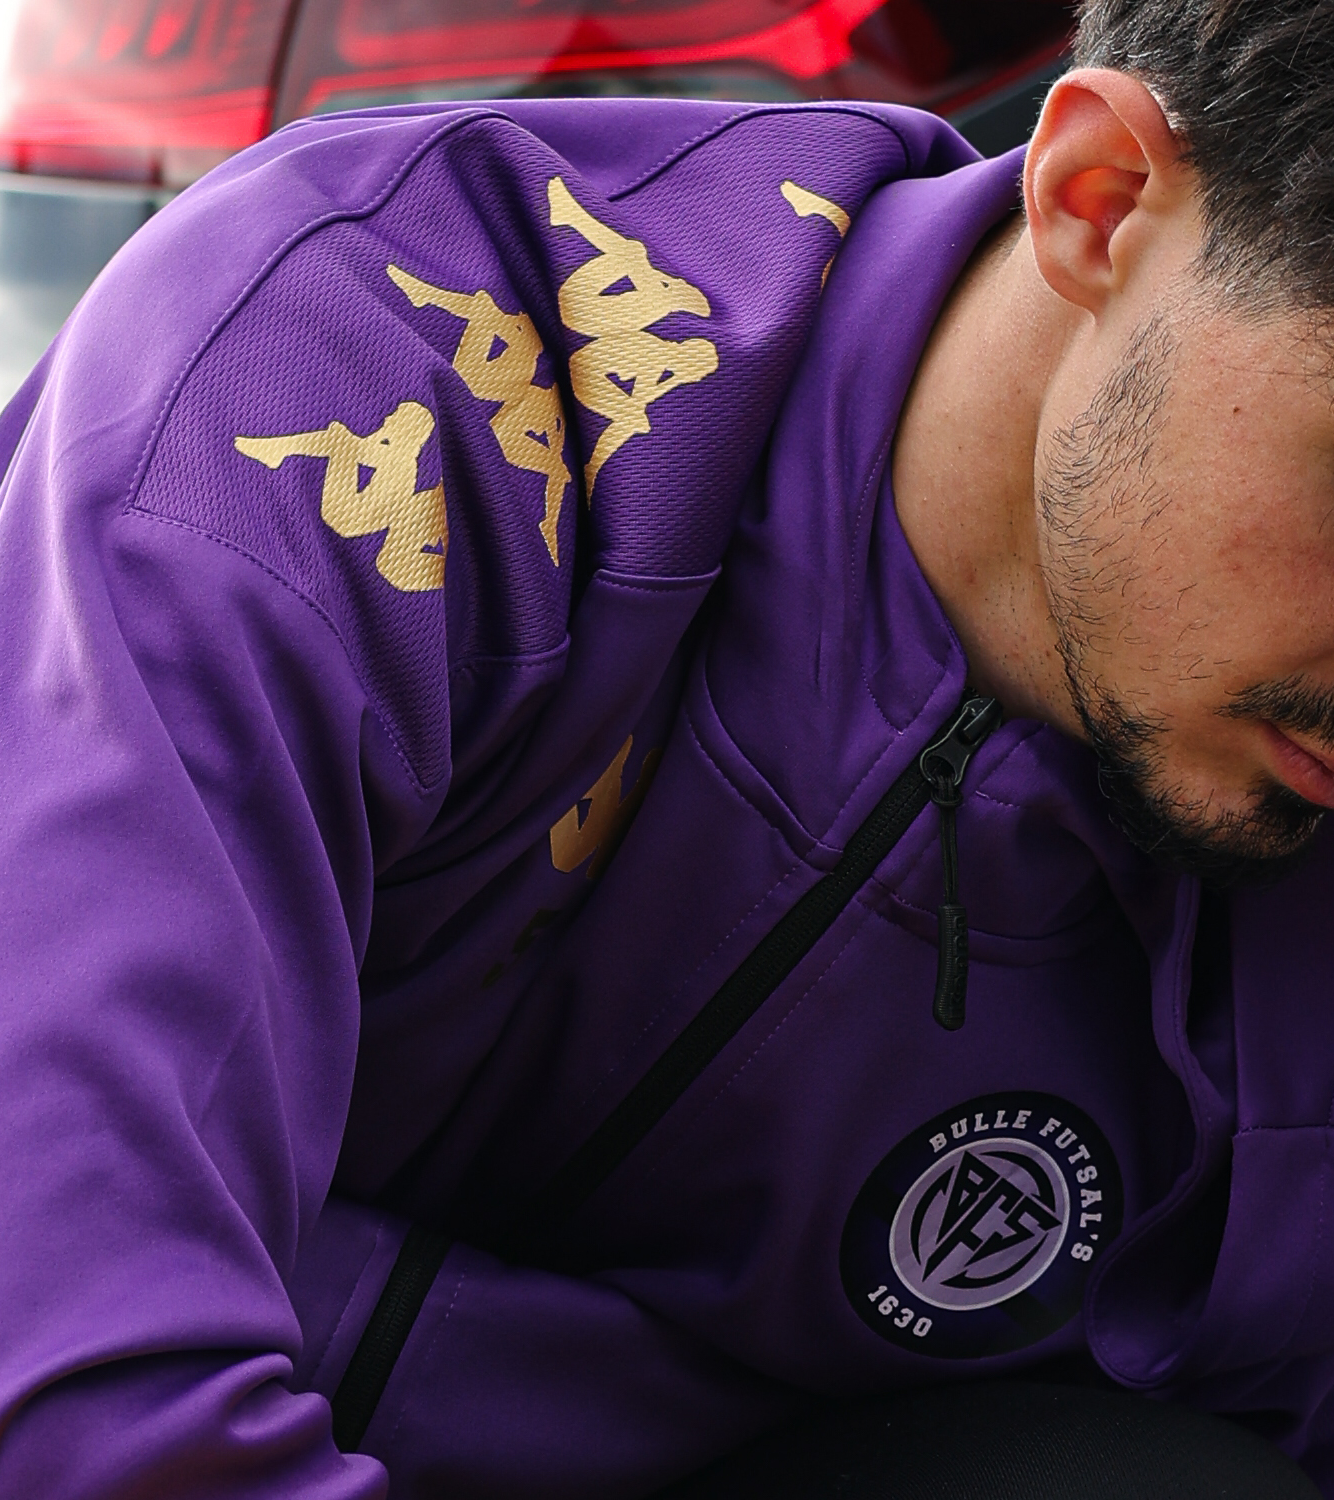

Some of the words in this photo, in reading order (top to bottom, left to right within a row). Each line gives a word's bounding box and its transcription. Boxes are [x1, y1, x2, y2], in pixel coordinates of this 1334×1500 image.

[928, 1109, 1032, 1153] BULLE
[1038, 1116, 1103, 1263] FUTSAL'S
[867, 1285, 934, 1338] 1630
